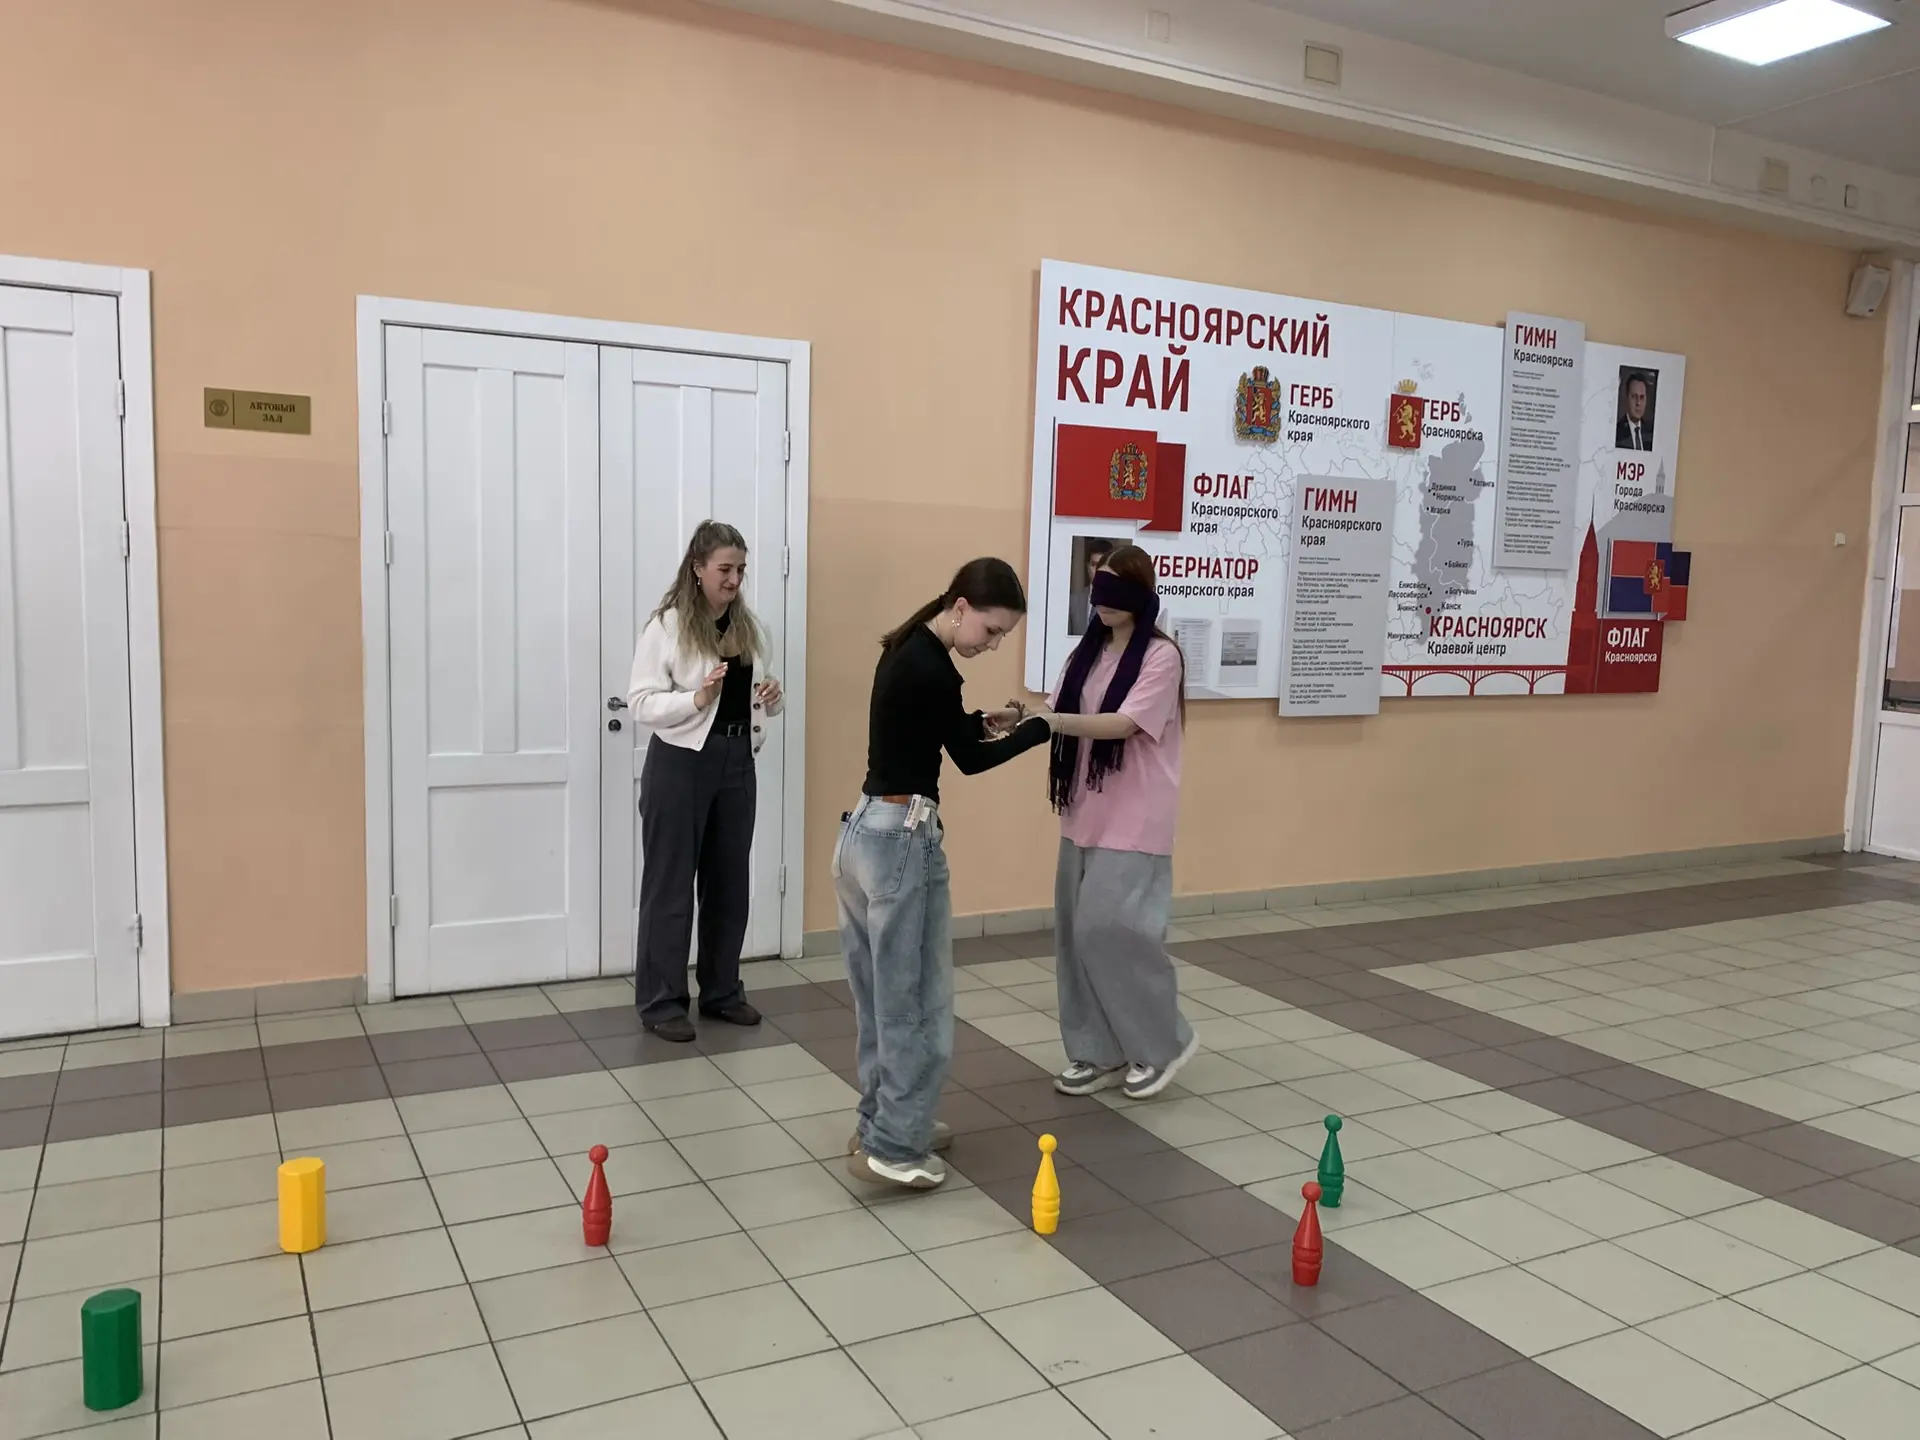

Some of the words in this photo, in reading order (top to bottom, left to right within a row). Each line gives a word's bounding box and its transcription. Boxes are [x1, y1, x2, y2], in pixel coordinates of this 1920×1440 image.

[1059, 286, 1330, 358] КРАСНОЯРСКИЙ
[1515, 324, 1557, 350] ГИМН
[1513, 348, 1574, 368] Красноярска
[1057, 343, 1190, 412] КРАЙ
[1290, 384, 1334, 409] ГЕРБ
[249, 401, 296, 413] АКТОВЫЙ
[1421, 399, 1460, 422] ГЕРБ
[262, 413, 283, 424] ЗАЛ
[1288, 410, 1370, 430] Красноярского
[1287, 429, 1313, 443] края
[1616, 461, 1645, 481] МЭР
[1193, 472, 1255, 500] ФЛАГ
[1615, 483, 1643, 498] Города
[1304, 487, 1358, 513] ГИМН
[1613, 498, 1666, 514] Красноярска
[1191, 501, 1279, 520] Красноярского
[1190, 520, 1218, 535] края
[1301, 515, 1382, 532] Красноярского
[1300, 535, 1326, 548] края
[1150, 555, 1259, 580] УБЕРНАТОР
[1227, 586, 1255, 600] края
[1429, 615, 1548, 639] КРАСНОЯРСК
[1607, 627, 1650, 648] ФЛАГ
[1427, 641, 1474, 656] Краевой
[1476, 643, 1507, 656] центр
[1605, 651, 1657, 664] Красноярска
